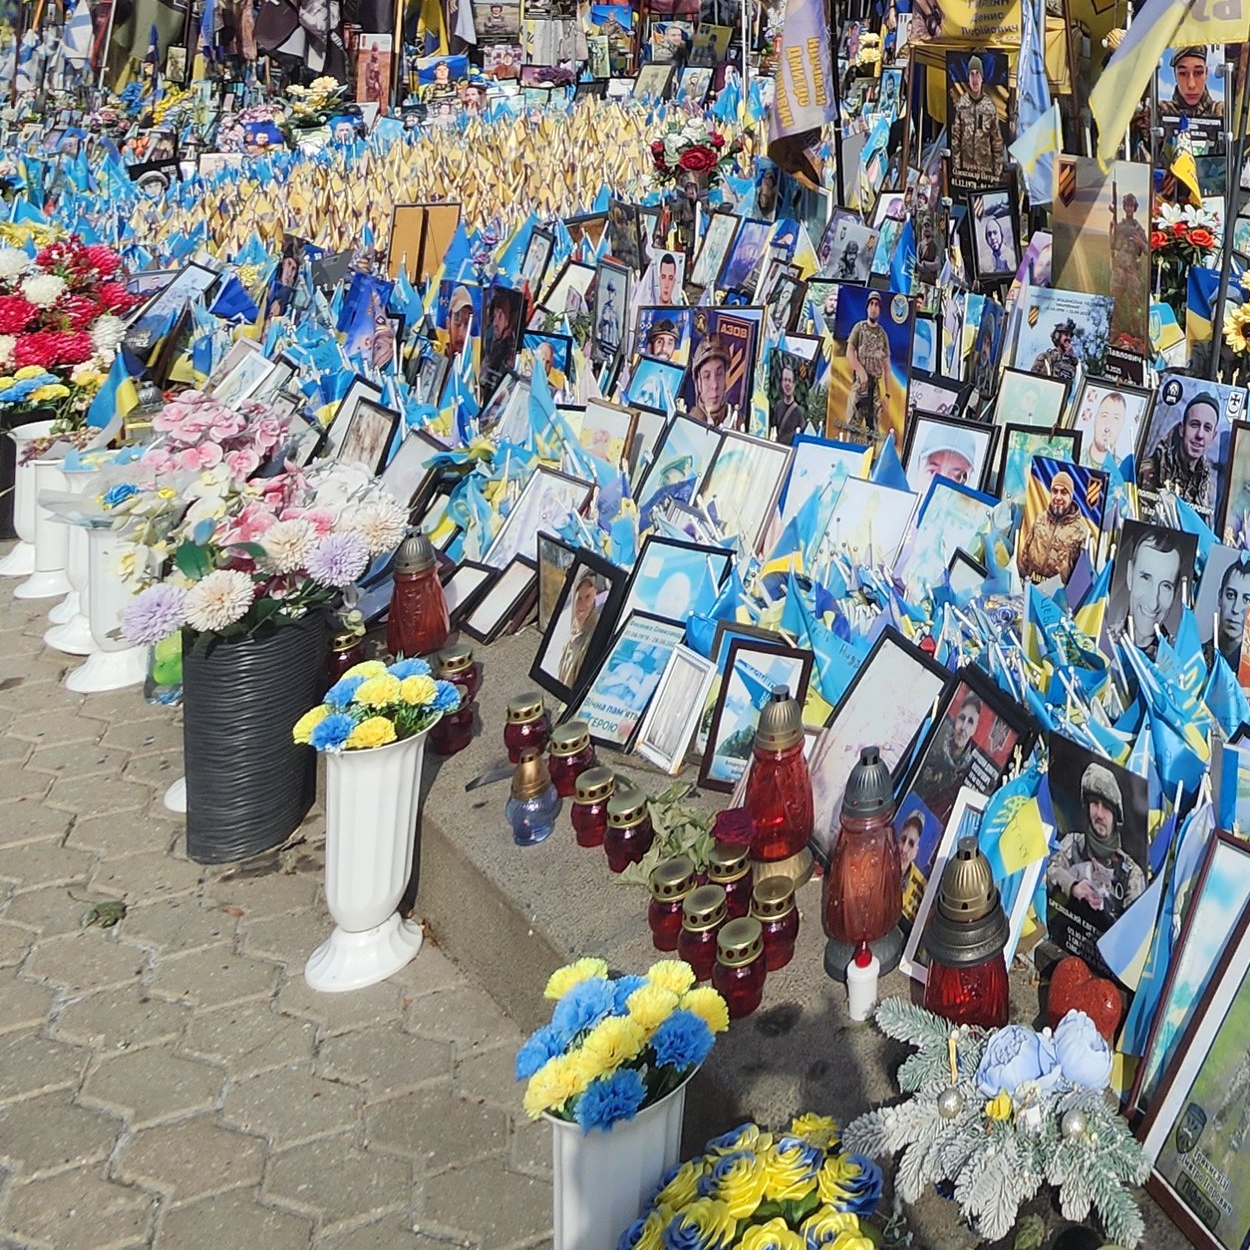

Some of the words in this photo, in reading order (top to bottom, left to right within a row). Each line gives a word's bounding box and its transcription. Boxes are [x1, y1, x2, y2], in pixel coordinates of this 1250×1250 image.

[720, 323, 748, 339] АЗОВ
[583, 696, 607, 710] Вічна
[588, 716, 618, 733] ГЕРОЮ
